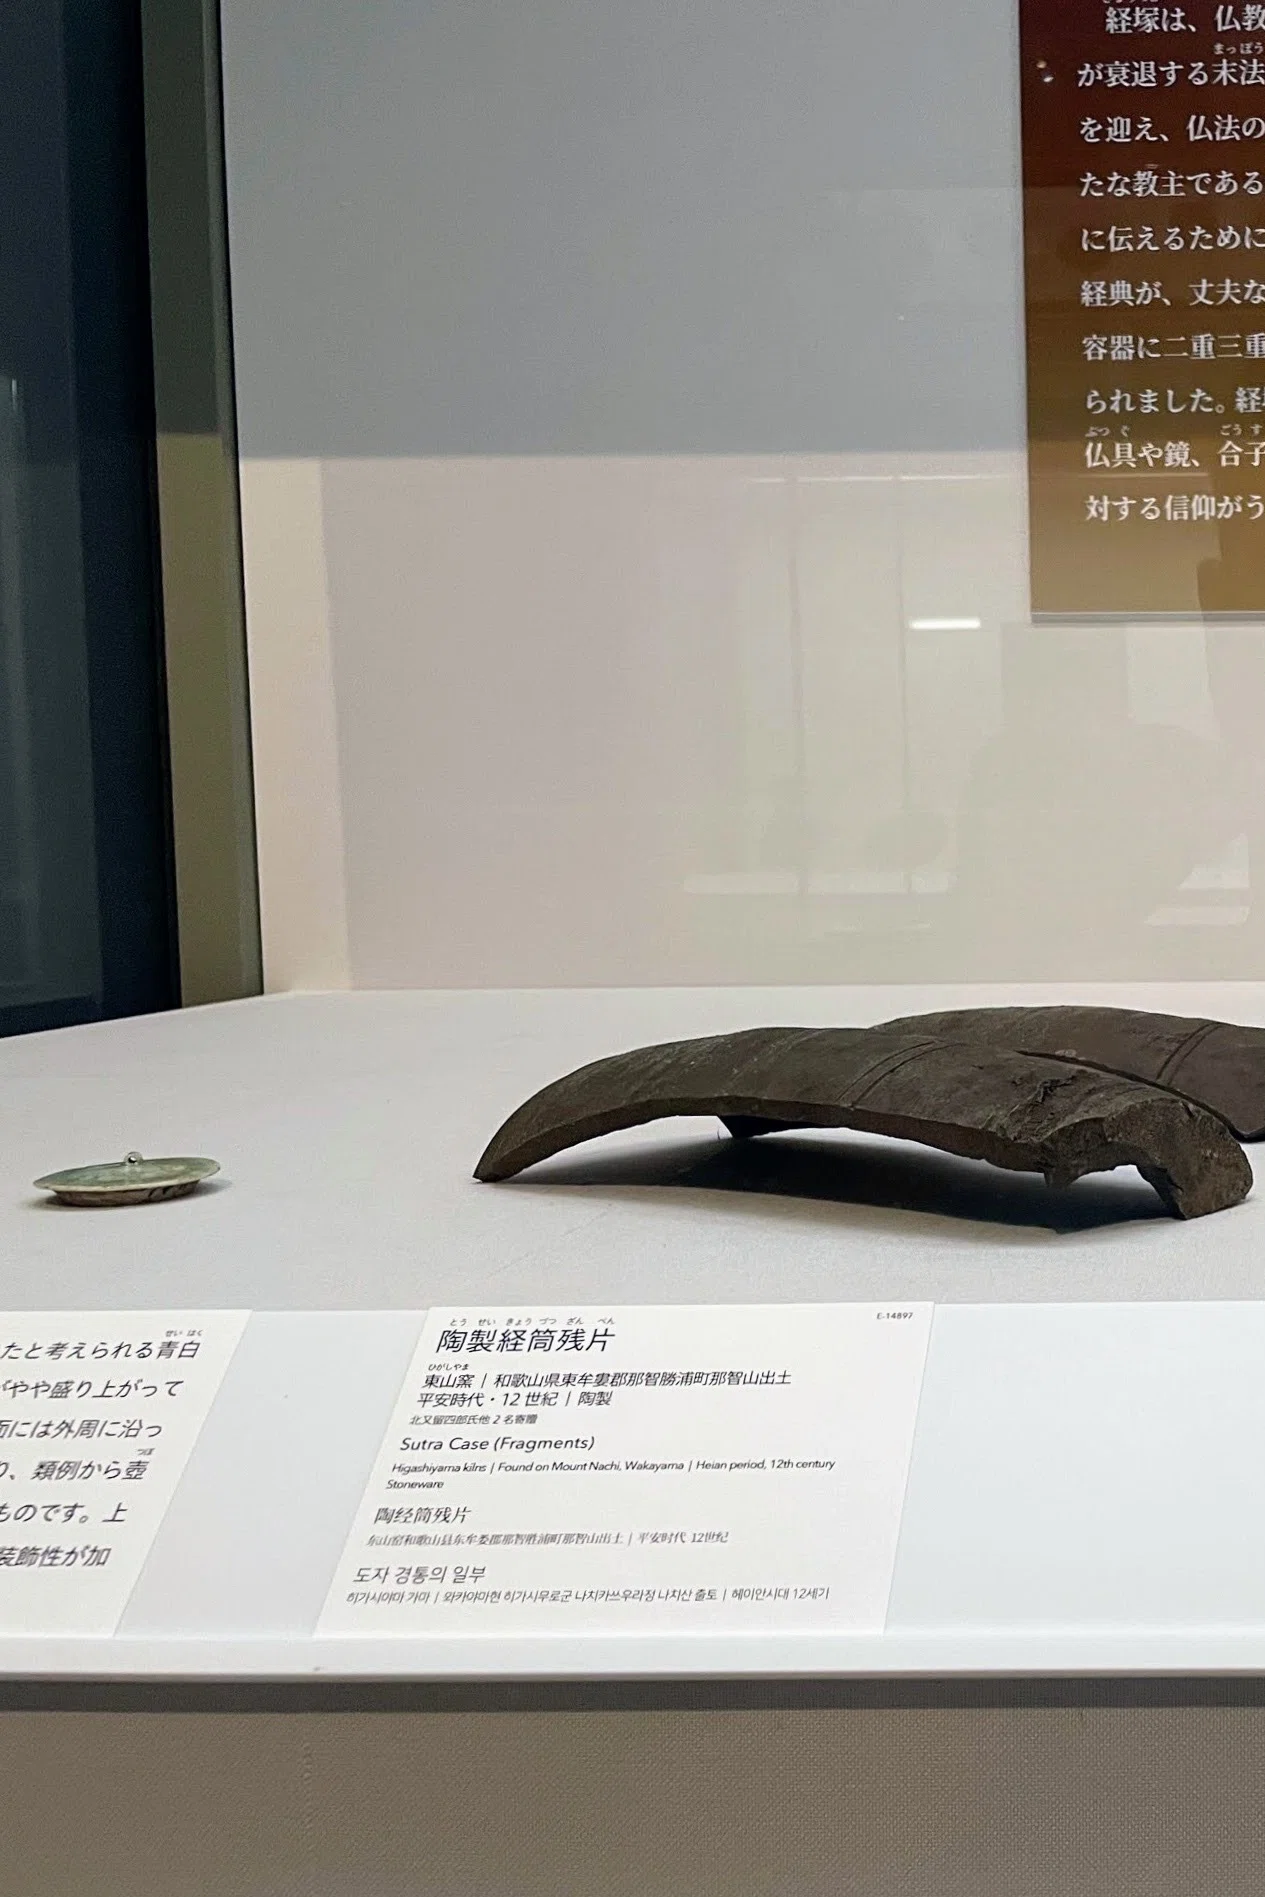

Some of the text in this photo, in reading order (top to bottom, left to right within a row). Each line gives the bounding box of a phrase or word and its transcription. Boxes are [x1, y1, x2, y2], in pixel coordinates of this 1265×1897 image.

[436, 1329, 615, 1352] 陶製経筒残片
[578, 1391, 613, 1406] 陶製
[400, 1437, 594, 1453] Sutra Case (Fragments)
[392, 1463, 461, 1475] Higashiyama
[463, 1463, 487, 1472] kilns
[498, 1462, 534, 1472] Found
[552, 1462, 587, 1471] Mount
[589, 1461, 621, 1471] Nachi,
[626, 1461, 684, 1472] Wakayama
[696, 1461, 727, 1469] Heian
[729, 1459, 766, 1472] period,
[772, 1459, 793, 1468] 12th
[796, 1461, 835, 1470] century
[386, 1480, 444, 1489] Stoneware
[353, 1566, 486, 1584] 도자 경통의 일부
